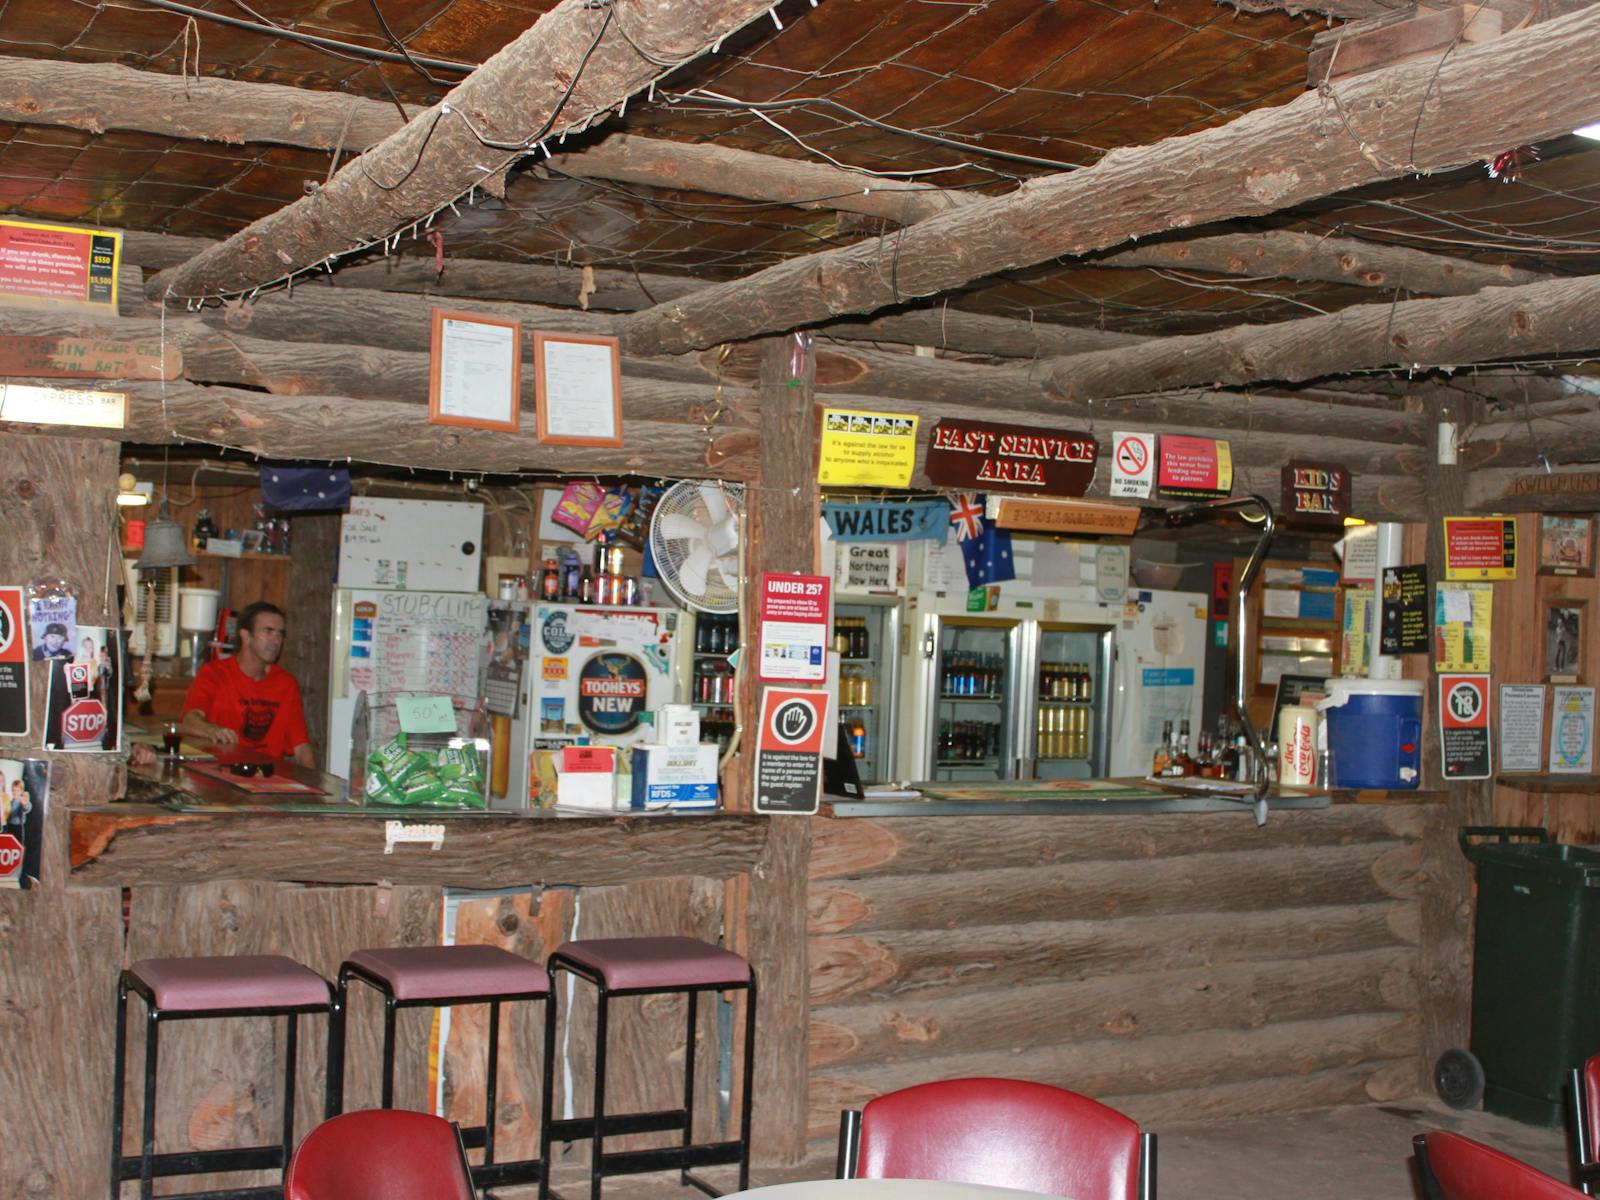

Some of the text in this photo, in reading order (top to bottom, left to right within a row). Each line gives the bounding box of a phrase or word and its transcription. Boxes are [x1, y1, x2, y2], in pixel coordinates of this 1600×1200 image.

[933, 427, 1096, 463] FAST SERVICE
[976, 460, 1046, 485] AREA
[1293, 468, 1342, 491] KIDS
[1124, 479, 1149, 487] SMOKING
[1295, 492, 1340, 514] BAR
[835, 509, 915, 536] WALES
[850, 546, 890, 558] Great
[849, 562, 889, 572] Northern
[768, 581, 823, 595] UNDER 25?
[848, 577, 888, 585] Now Here
[543, 626, 574, 638] COL
[585, 680, 641, 694] TOOHEYS
[592, 698, 633, 713] NEW
[67, 714, 104, 732] STOP
